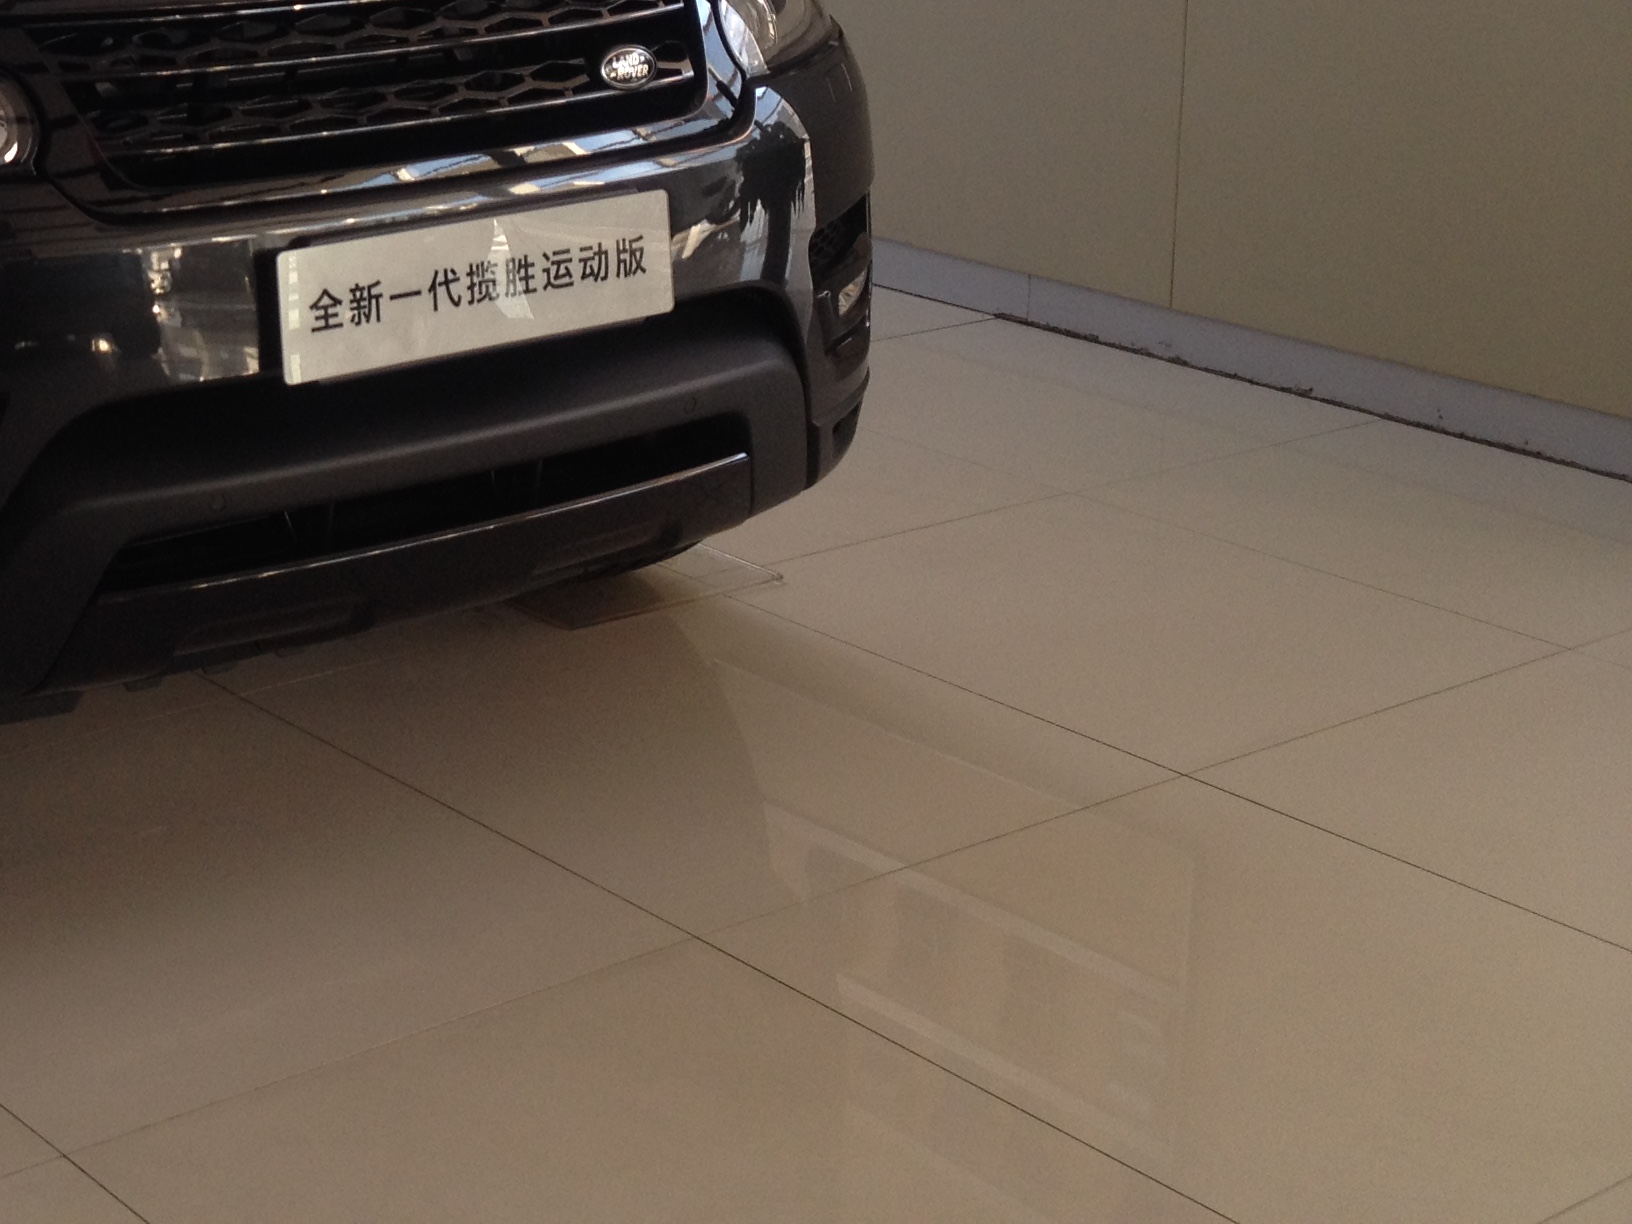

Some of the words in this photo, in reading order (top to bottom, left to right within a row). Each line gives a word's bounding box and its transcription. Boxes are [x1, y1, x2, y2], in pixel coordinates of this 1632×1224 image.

[612, 52, 640, 69] LAND
[616, 63, 649, 81] ROVER
[308, 234, 649, 334] 全新一代揽胜运动版
